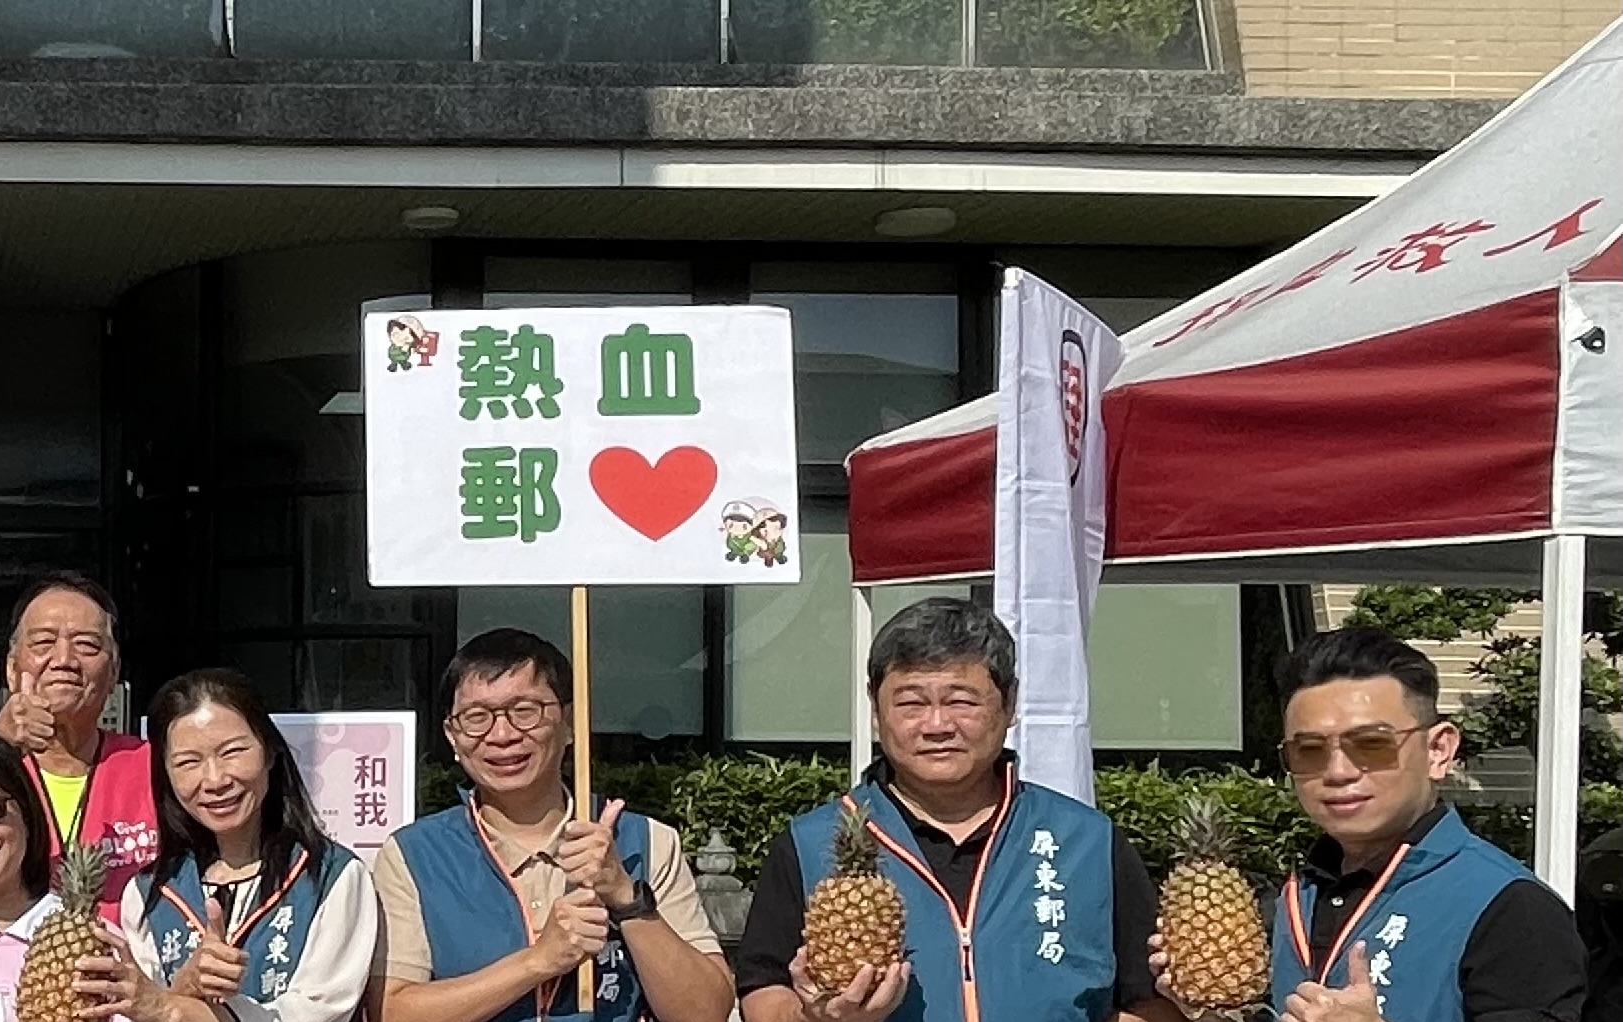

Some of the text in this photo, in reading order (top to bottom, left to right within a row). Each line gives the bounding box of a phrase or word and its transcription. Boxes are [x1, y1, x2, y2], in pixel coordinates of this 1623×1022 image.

[457, 324, 701, 420] 熱血
[459, 446, 561, 542] 郵
[1029, 829, 1066, 965] 屏東郵局
[1369, 913, 1409, 1015] 屏東
